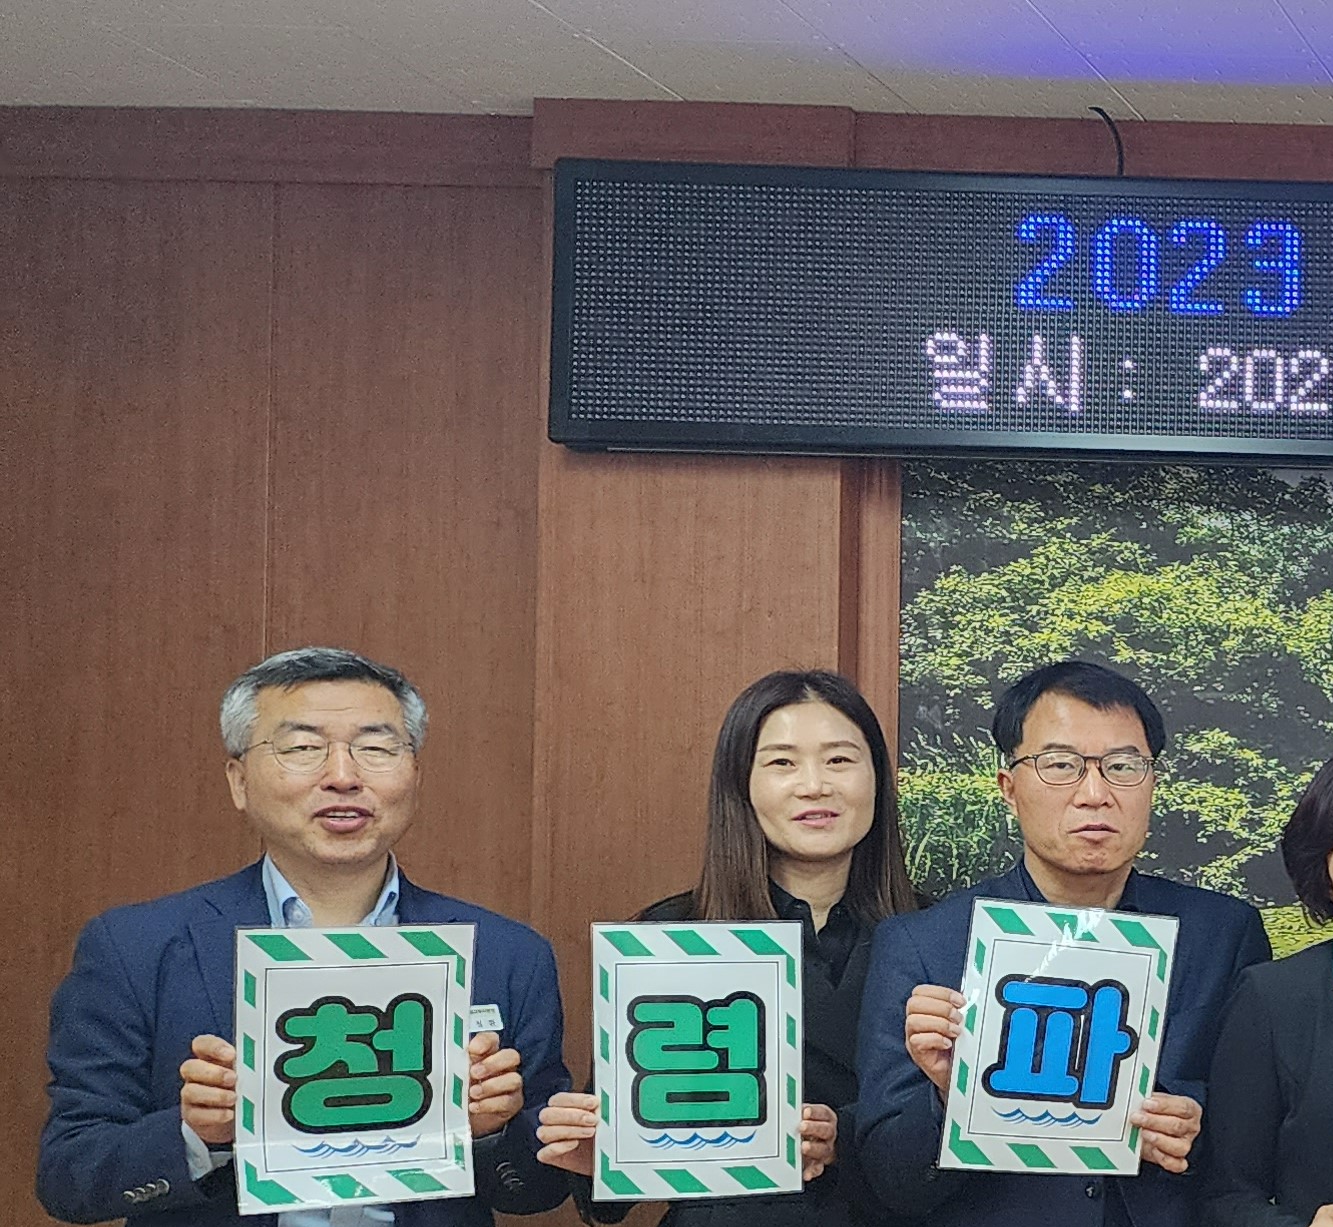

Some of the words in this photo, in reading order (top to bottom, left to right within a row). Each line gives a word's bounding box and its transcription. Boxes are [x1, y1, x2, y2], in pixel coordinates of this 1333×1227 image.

[274, 992, 433, 1133] 청
[627, 989, 766, 1128] 렴
[983, 973, 1139, 1109] 파
